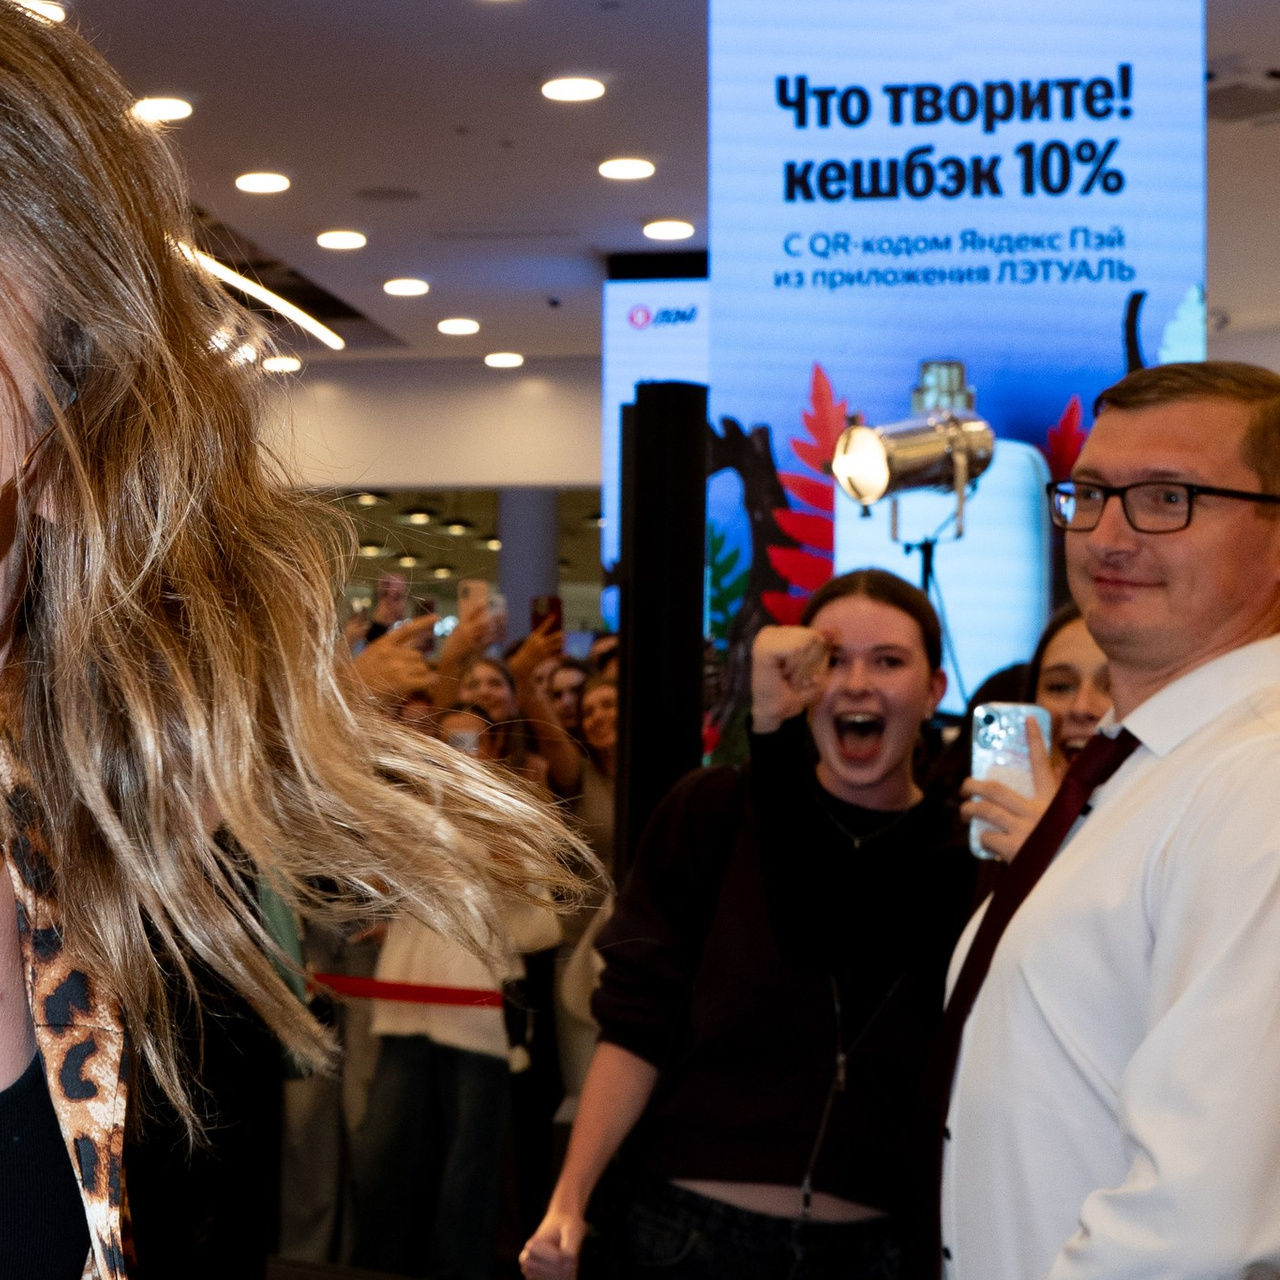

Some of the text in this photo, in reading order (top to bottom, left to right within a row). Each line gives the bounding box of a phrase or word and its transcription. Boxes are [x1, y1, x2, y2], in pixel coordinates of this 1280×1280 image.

[775, 62, 1134, 136] Что творите!
[783, 137, 1126, 204] кешбэк 10%
[782, 225, 1126, 261] С QR-кодом Яндекс Пэй
[773, 257, 1137, 293] из приложения ЛЭТУАЛЬ
